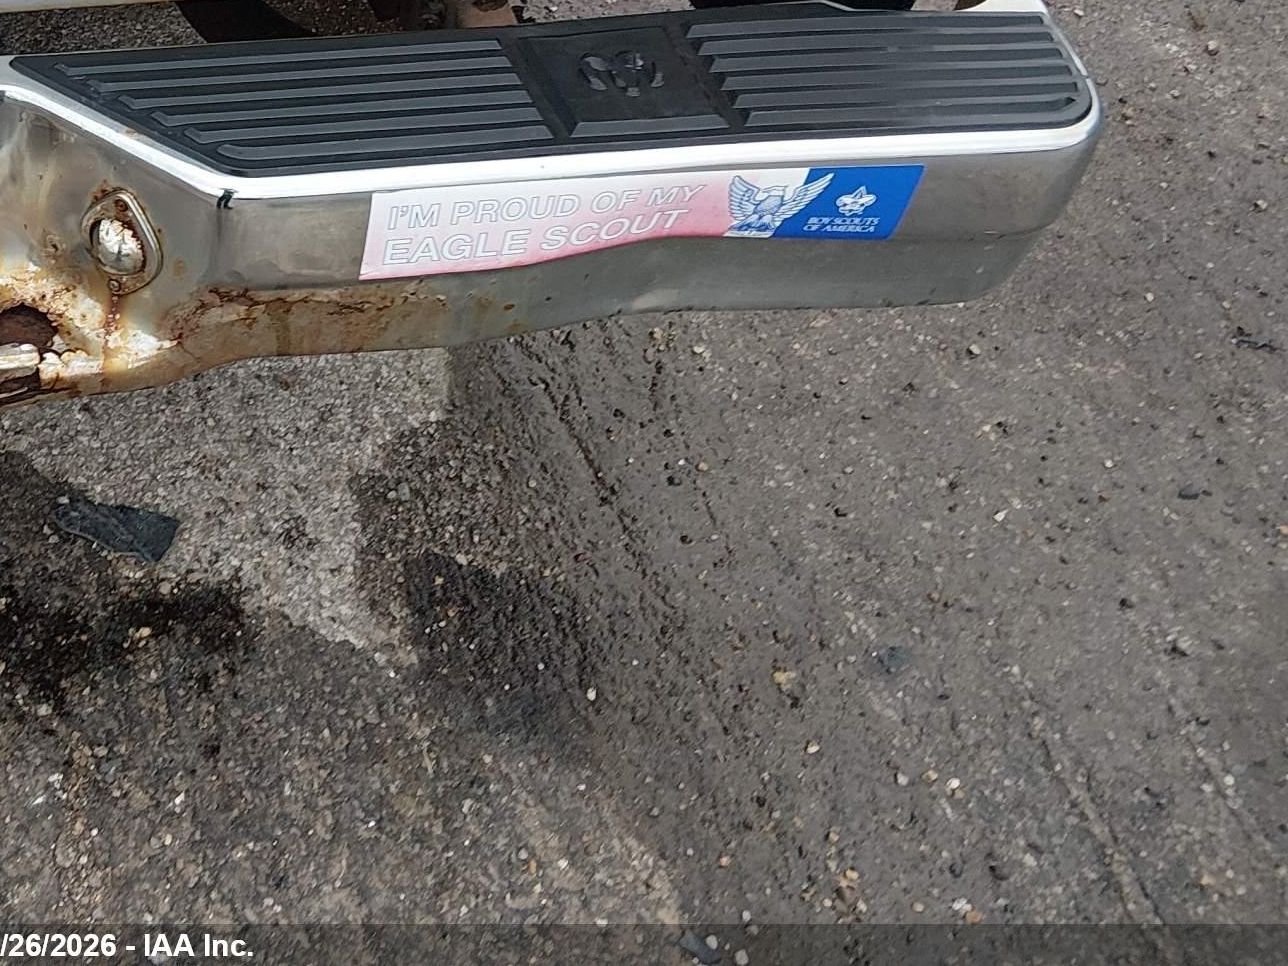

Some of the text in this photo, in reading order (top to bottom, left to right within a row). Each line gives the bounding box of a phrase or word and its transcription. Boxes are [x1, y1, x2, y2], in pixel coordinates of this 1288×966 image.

[387, 184, 707, 231] I'M PROUD OF MY
[807, 216, 881, 225] BOY SCOUTS
[382, 208, 691, 265] EAGLE SCOUT
[802, 224, 876, 233] OF AMERICA
